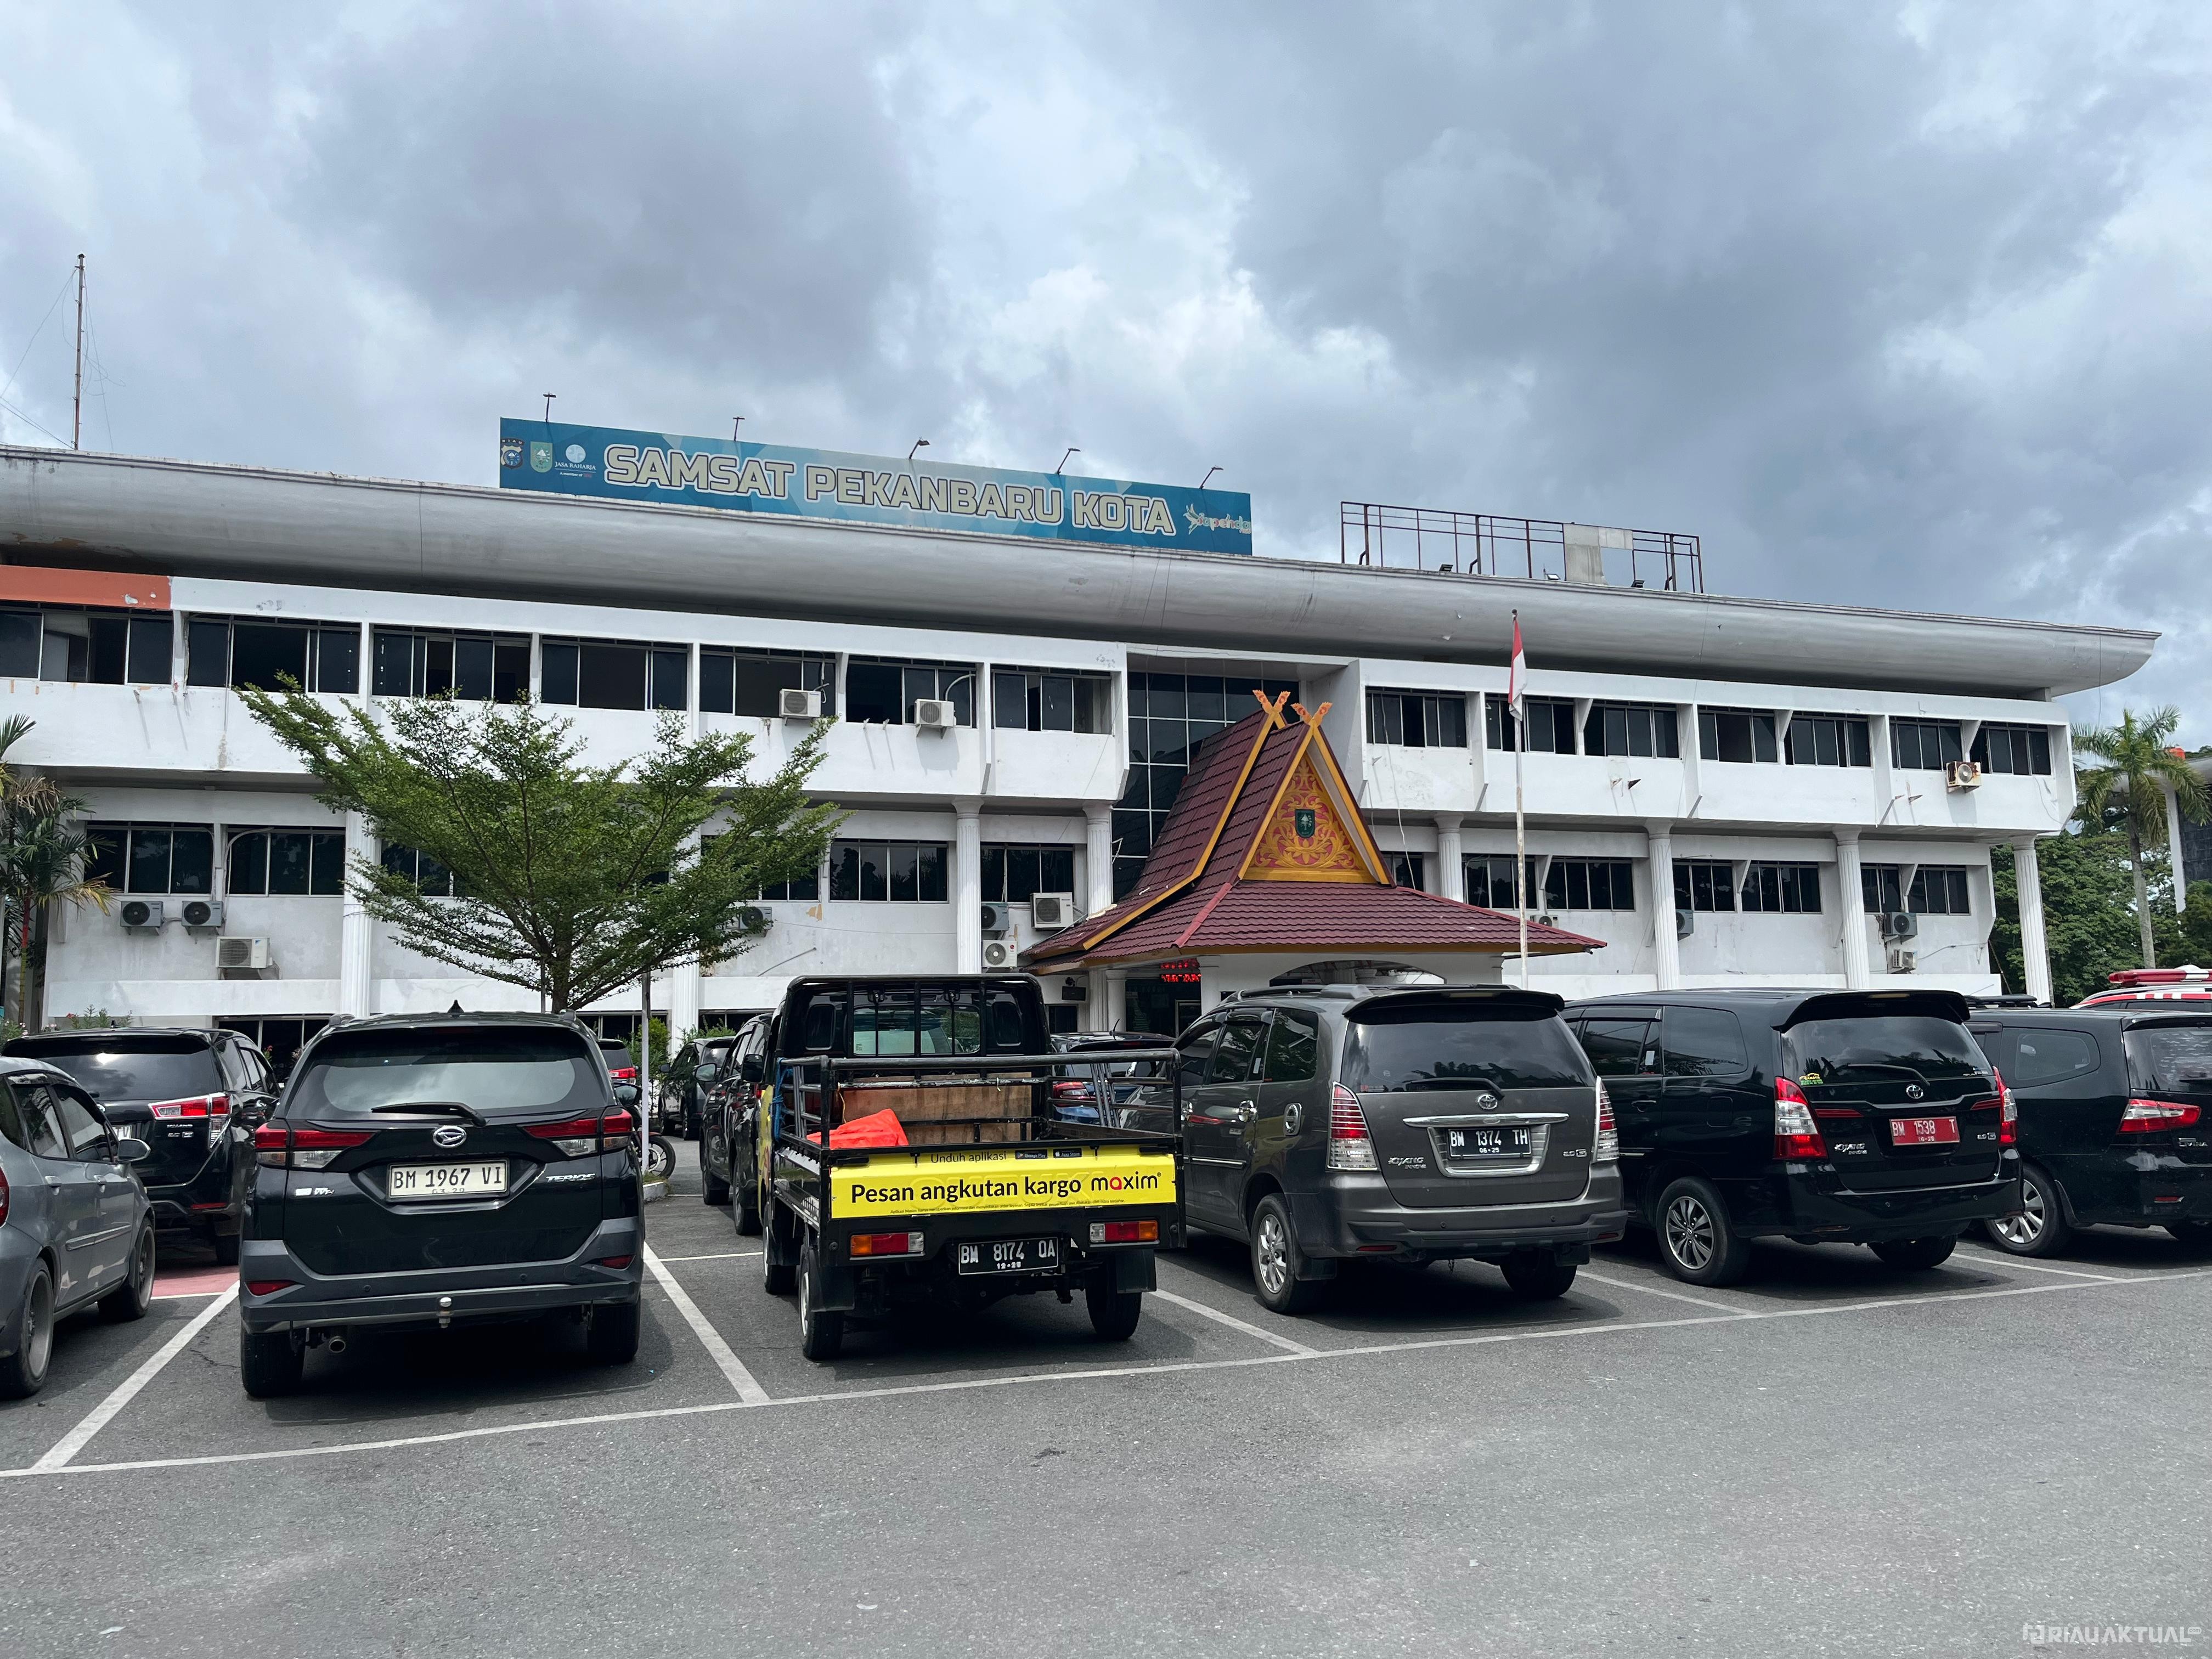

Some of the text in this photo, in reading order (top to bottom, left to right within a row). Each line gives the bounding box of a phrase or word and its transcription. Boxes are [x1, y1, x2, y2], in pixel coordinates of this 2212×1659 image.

[606, 445, 1175, 535] SAMSAT PEKANBARU KOTA
[1450, 1129, 1528, 1147] BM 1374 TH
[1892, 1119, 1955, 1137] BM 1538 T
[930, 1150, 1007, 1163] Unduh aplikasi
[394, 1166, 502, 1189] BM 1967 VI
[546, 1173, 596, 1183] TERIOS
[851, 1176, 1081, 1203] Pesan angkutan kargo
[961, 1245, 979, 1264] BM
[993, 1242, 1025, 1261] 8174
